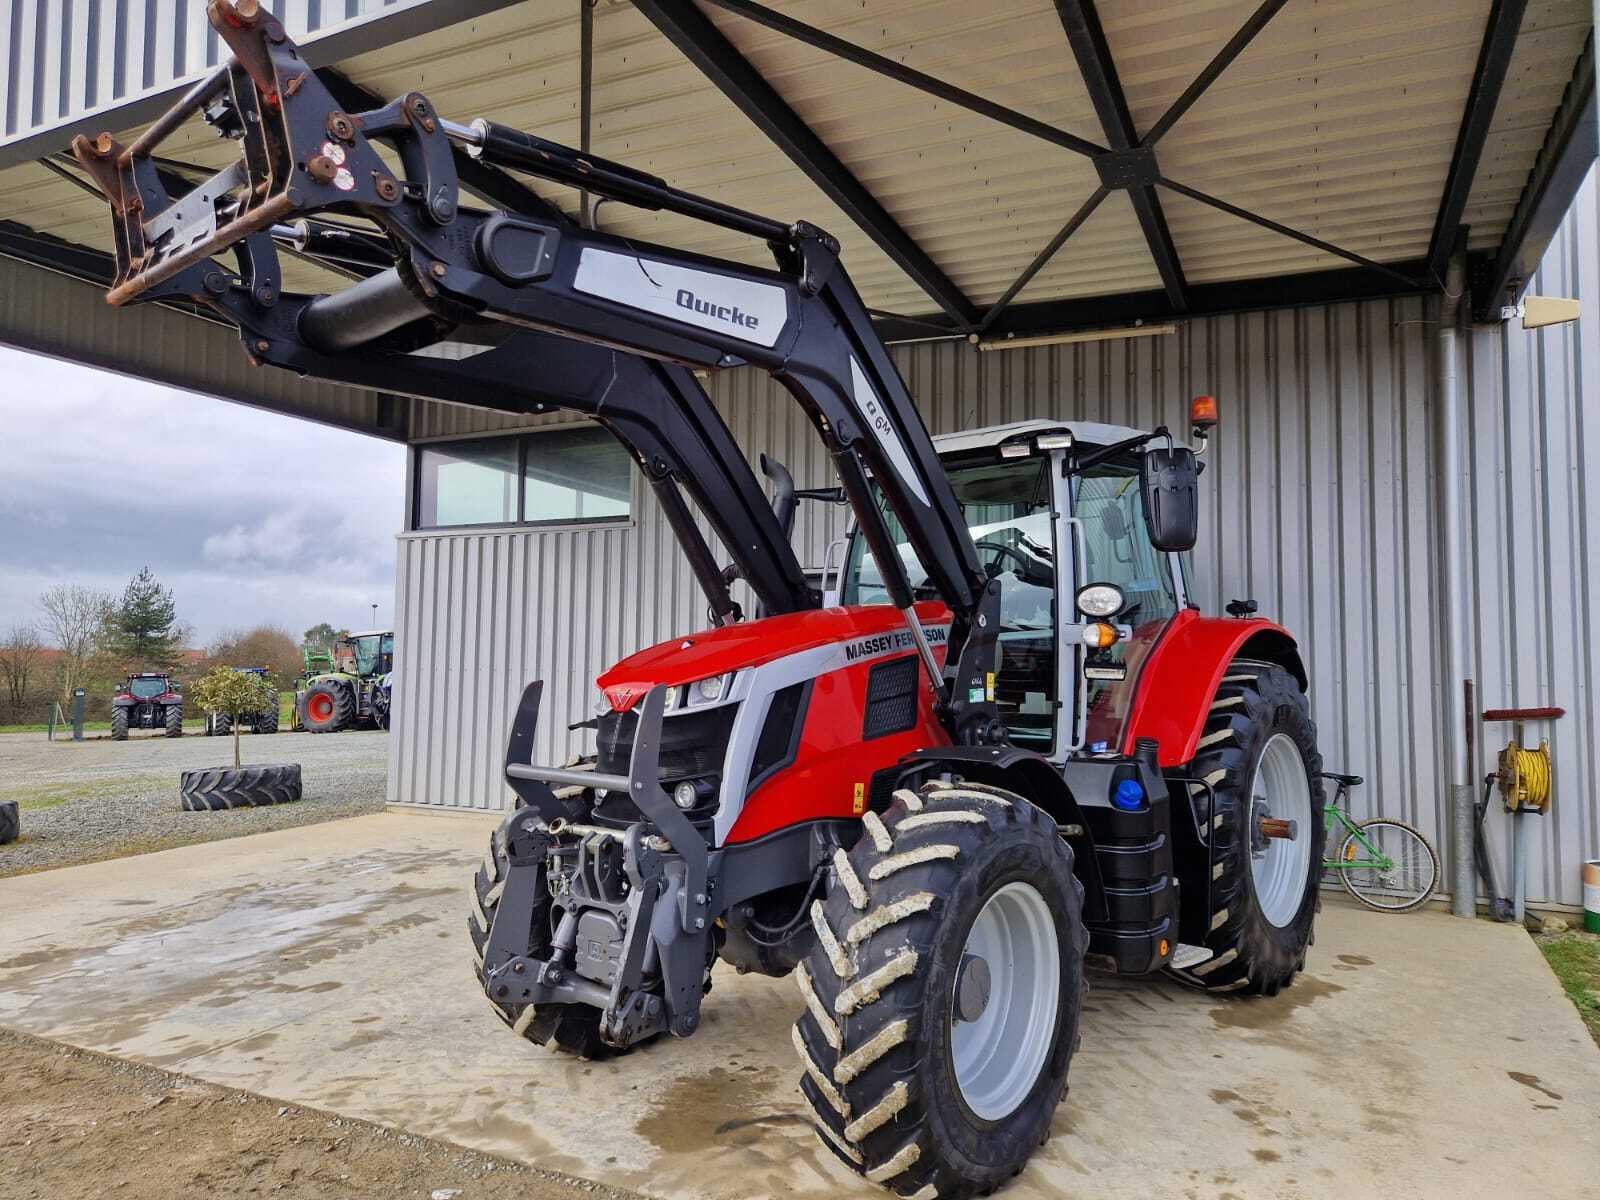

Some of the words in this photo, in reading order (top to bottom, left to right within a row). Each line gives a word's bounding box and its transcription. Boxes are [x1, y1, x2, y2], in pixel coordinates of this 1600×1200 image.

[676, 288, 759, 329] Quicke
[845, 635, 892, 661] MASSEY
[894, 628, 946, 648] FERSON
